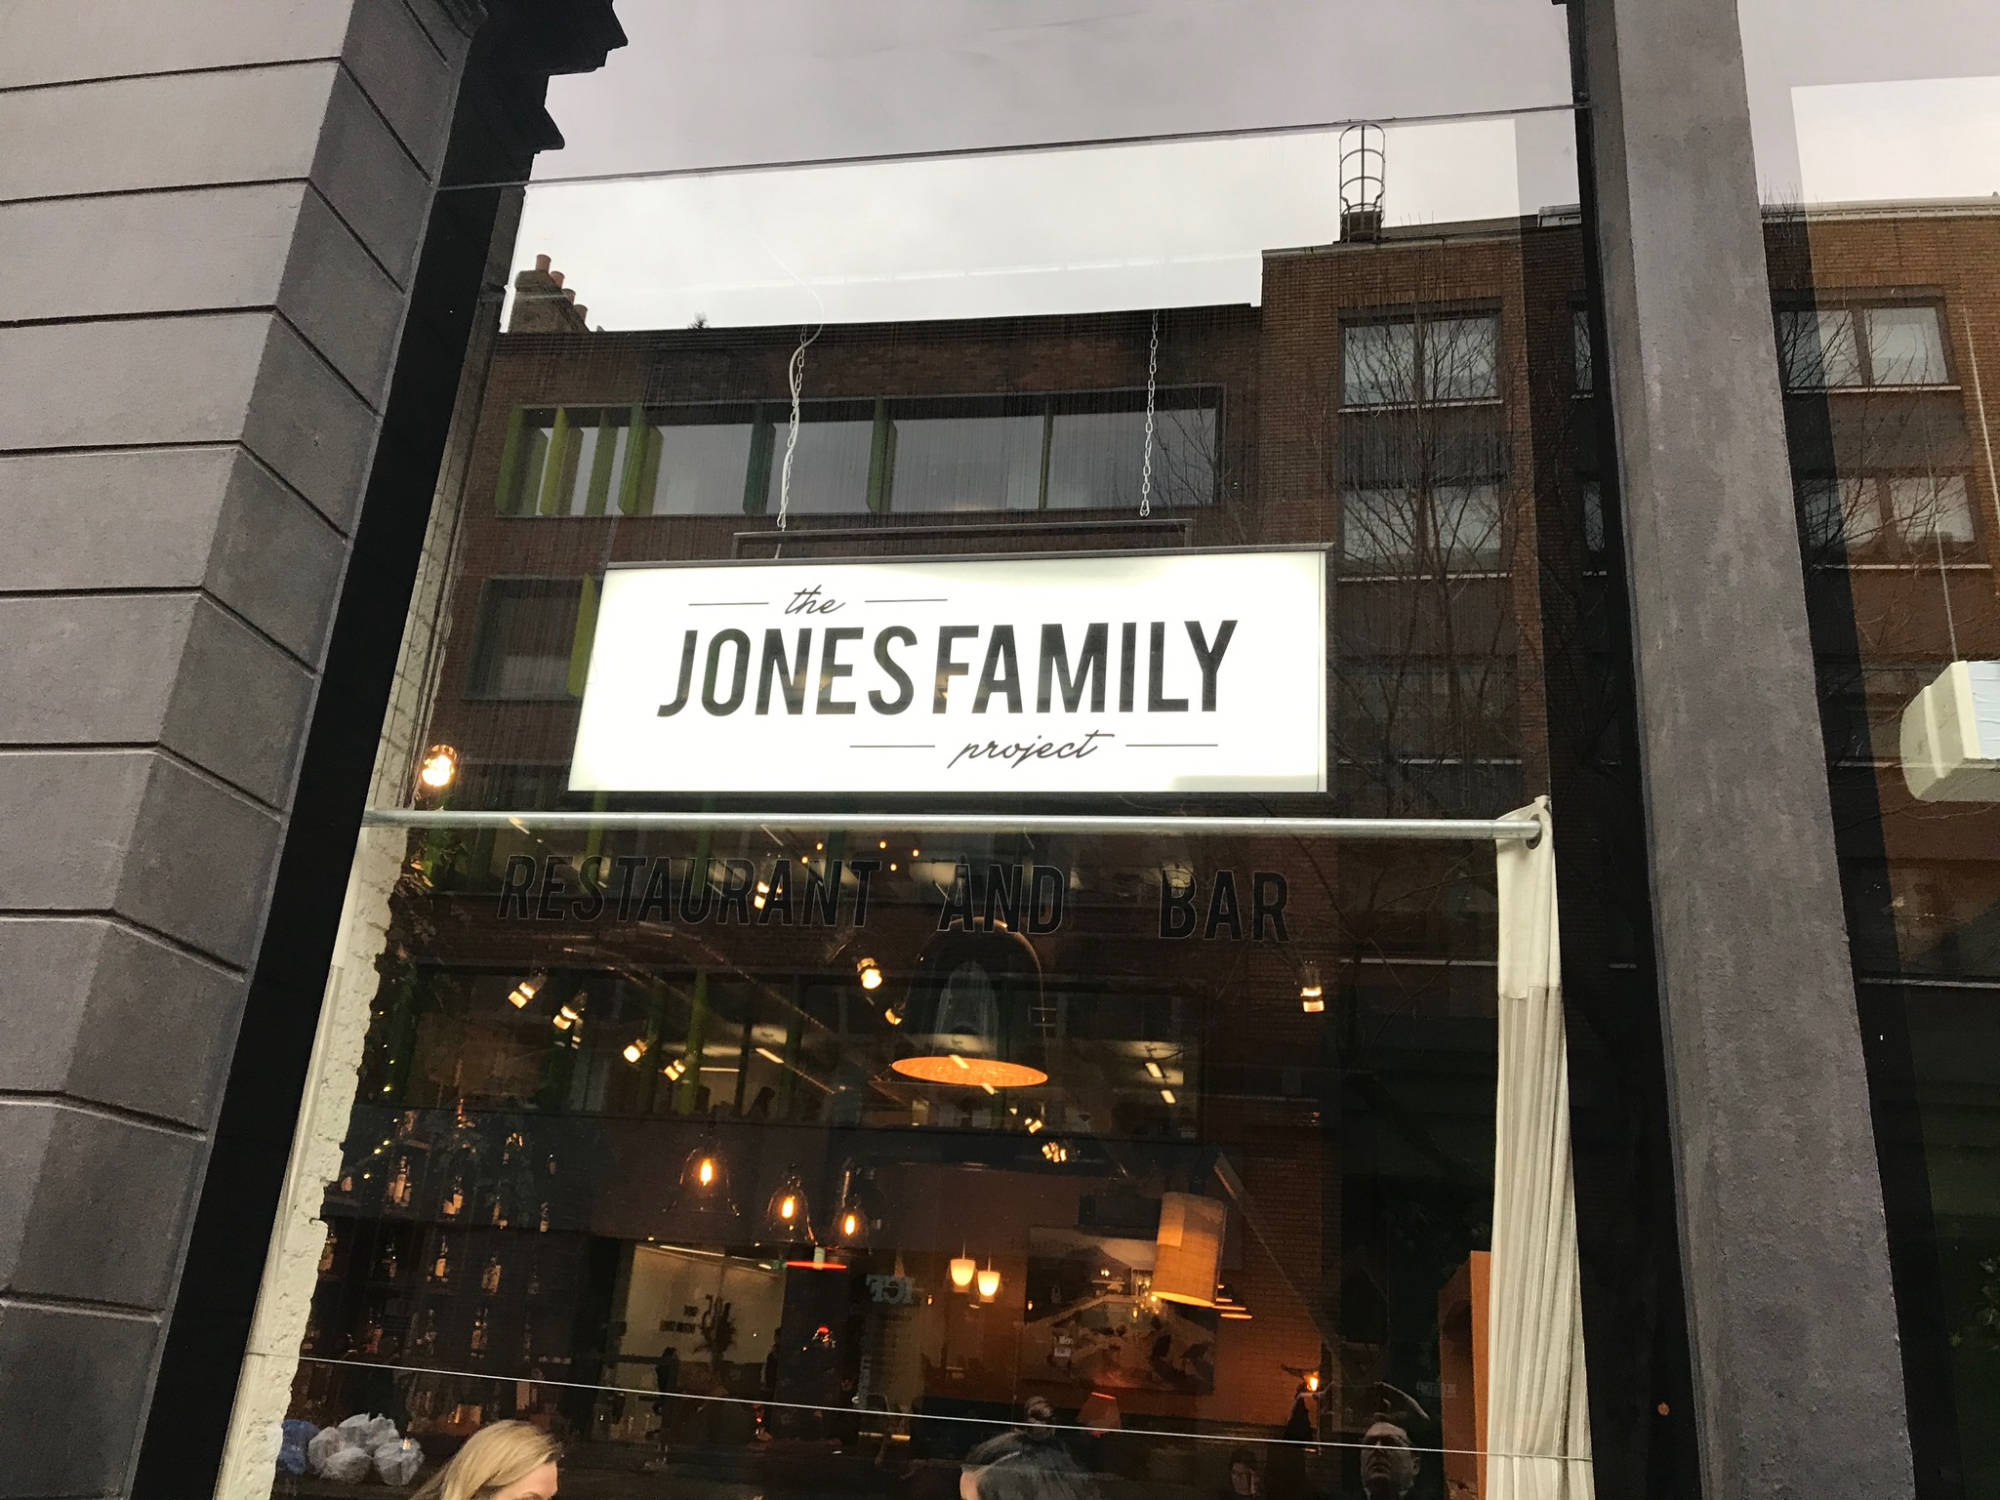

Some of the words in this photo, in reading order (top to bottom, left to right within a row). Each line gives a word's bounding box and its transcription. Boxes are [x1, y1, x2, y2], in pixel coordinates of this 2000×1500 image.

[784, 584, 846, 615] the
[657, 626, 918, 718] JONES
[931, 620, 1239, 714] FAMILY
[946, 729, 1116, 770] project
[497, 854, 882, 928] RESTAURANT
[936, 863, 1064, 935] AND
[1158, 868, 1290, 944] BAR
